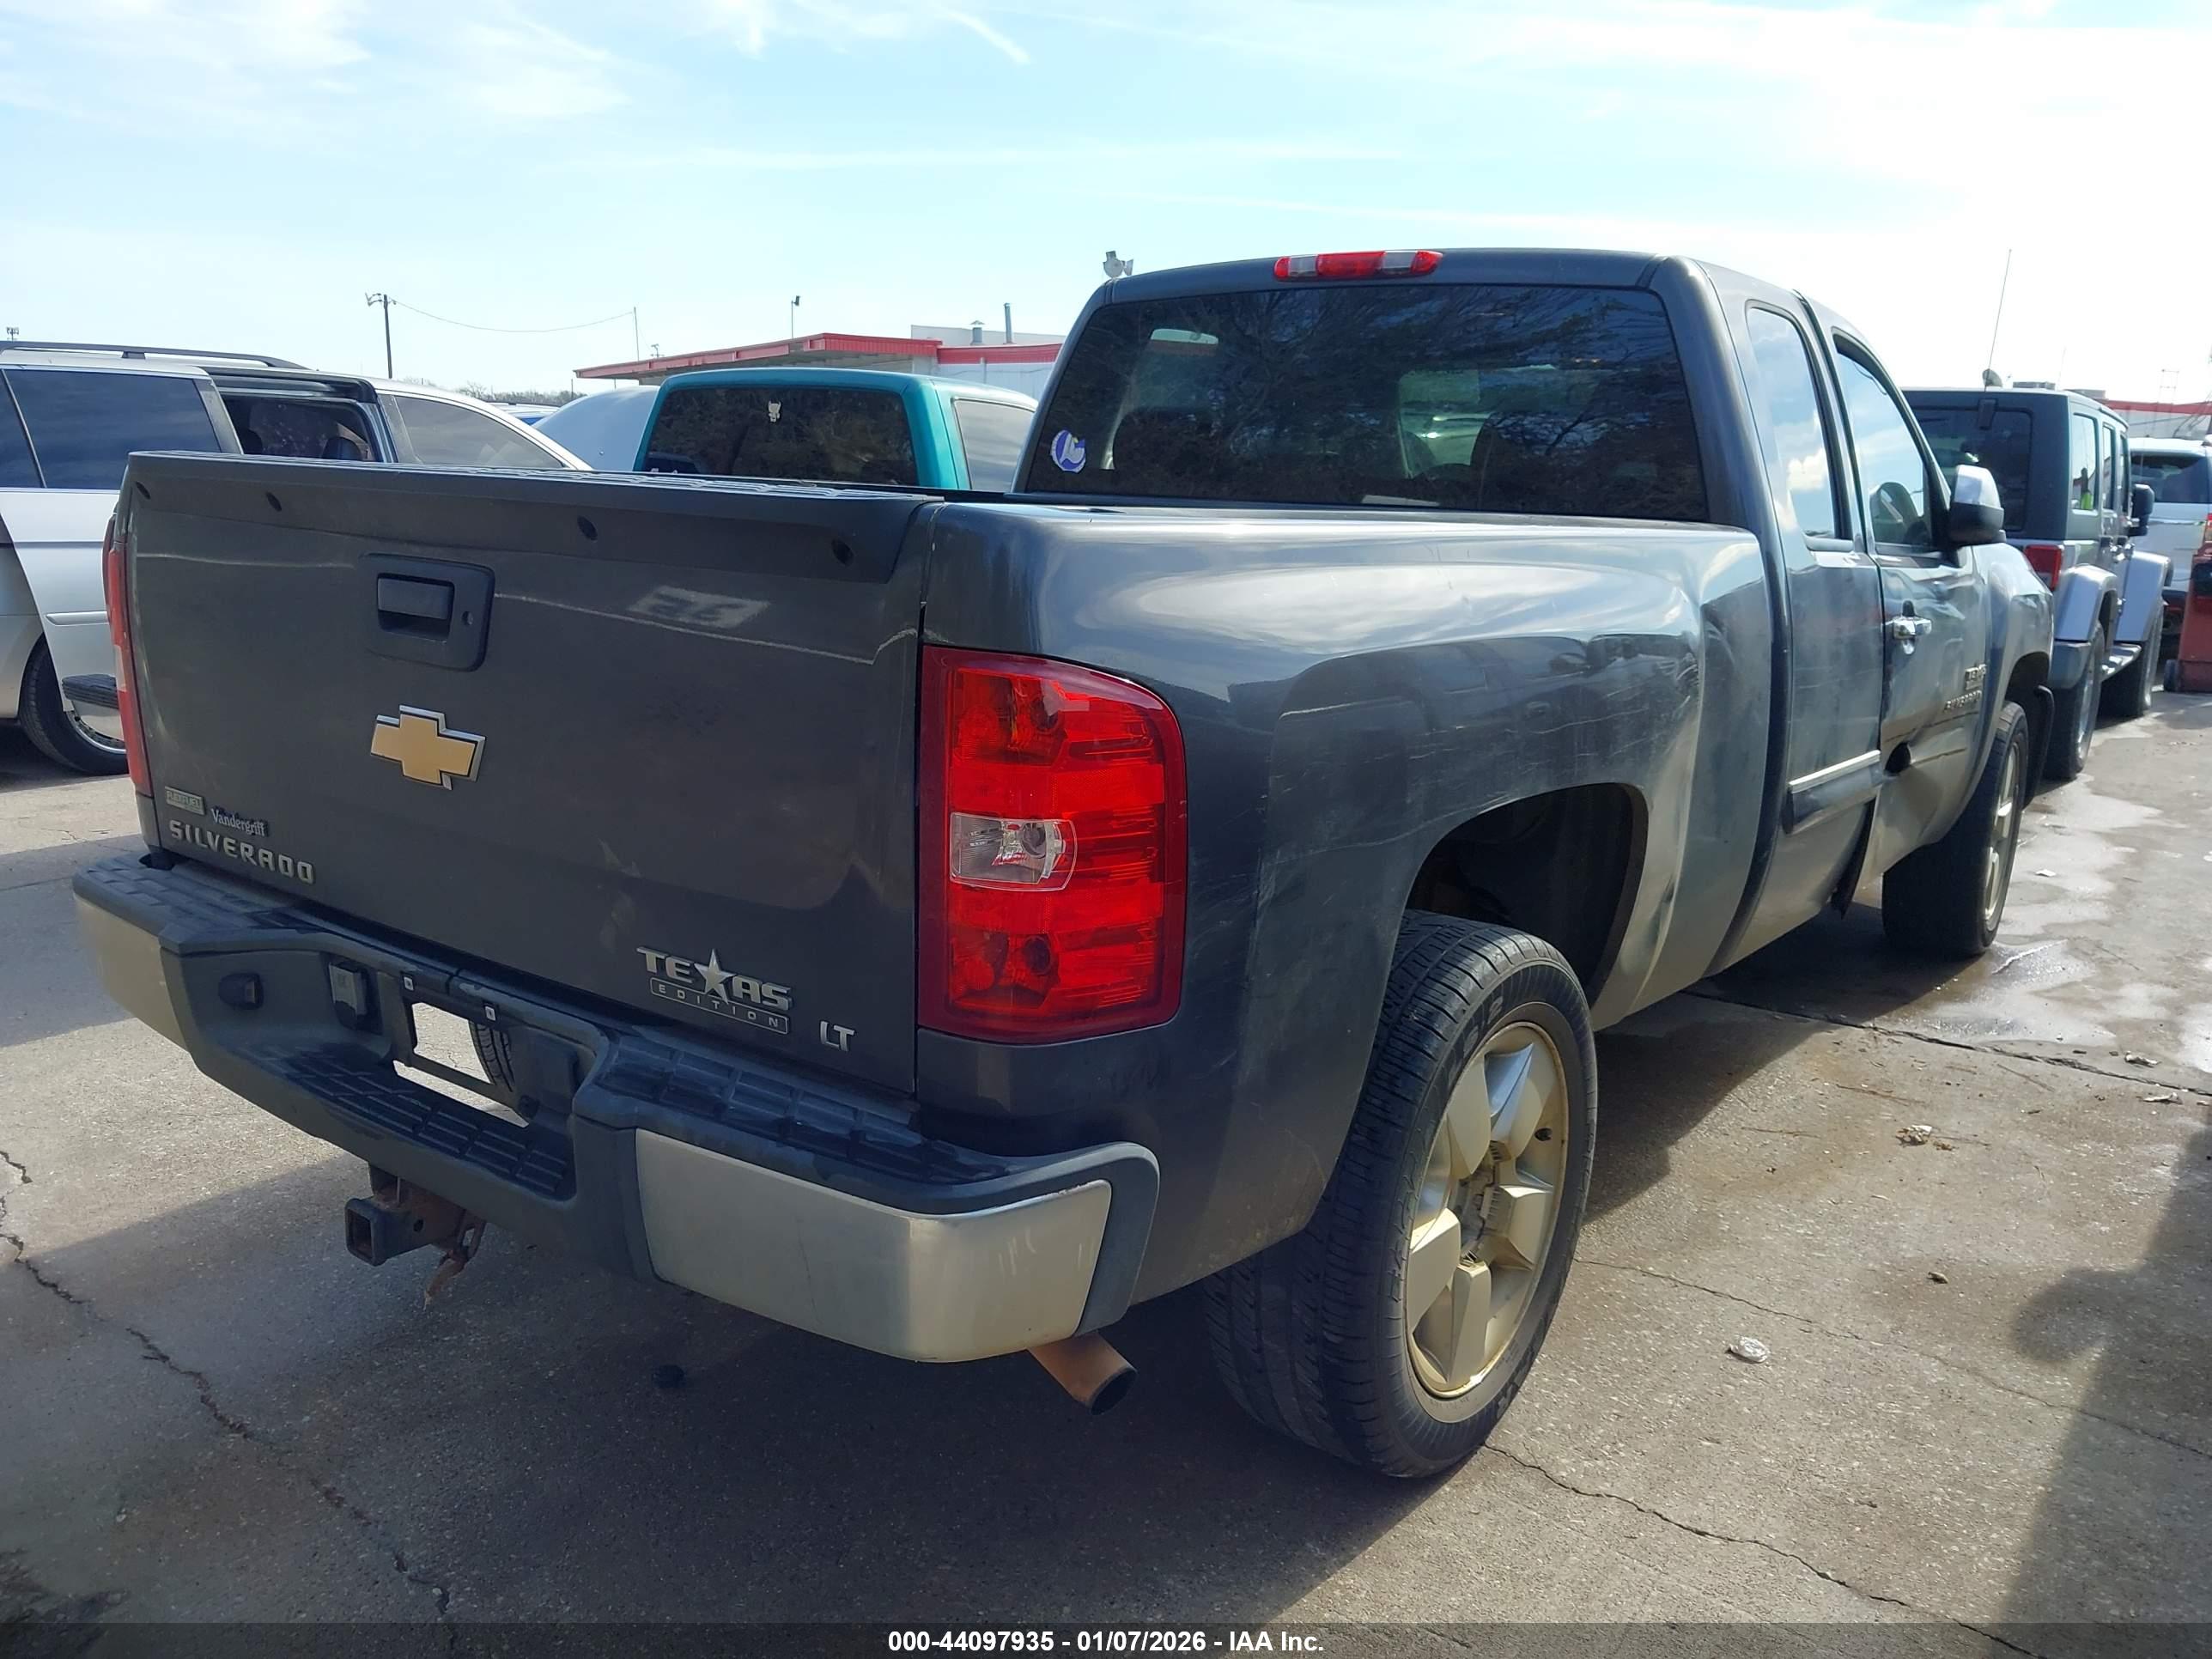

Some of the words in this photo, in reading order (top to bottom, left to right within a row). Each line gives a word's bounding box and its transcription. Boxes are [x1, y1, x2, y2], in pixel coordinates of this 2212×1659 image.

[210, 808, 265, 836] Vandergriff
[169, 819, 314, 884] SILVERADO
[636, 946, 793, 1011] TEXAS
[658, 983, 779, 1028] EDITION
[820, 1020, 855, 1052] LT
